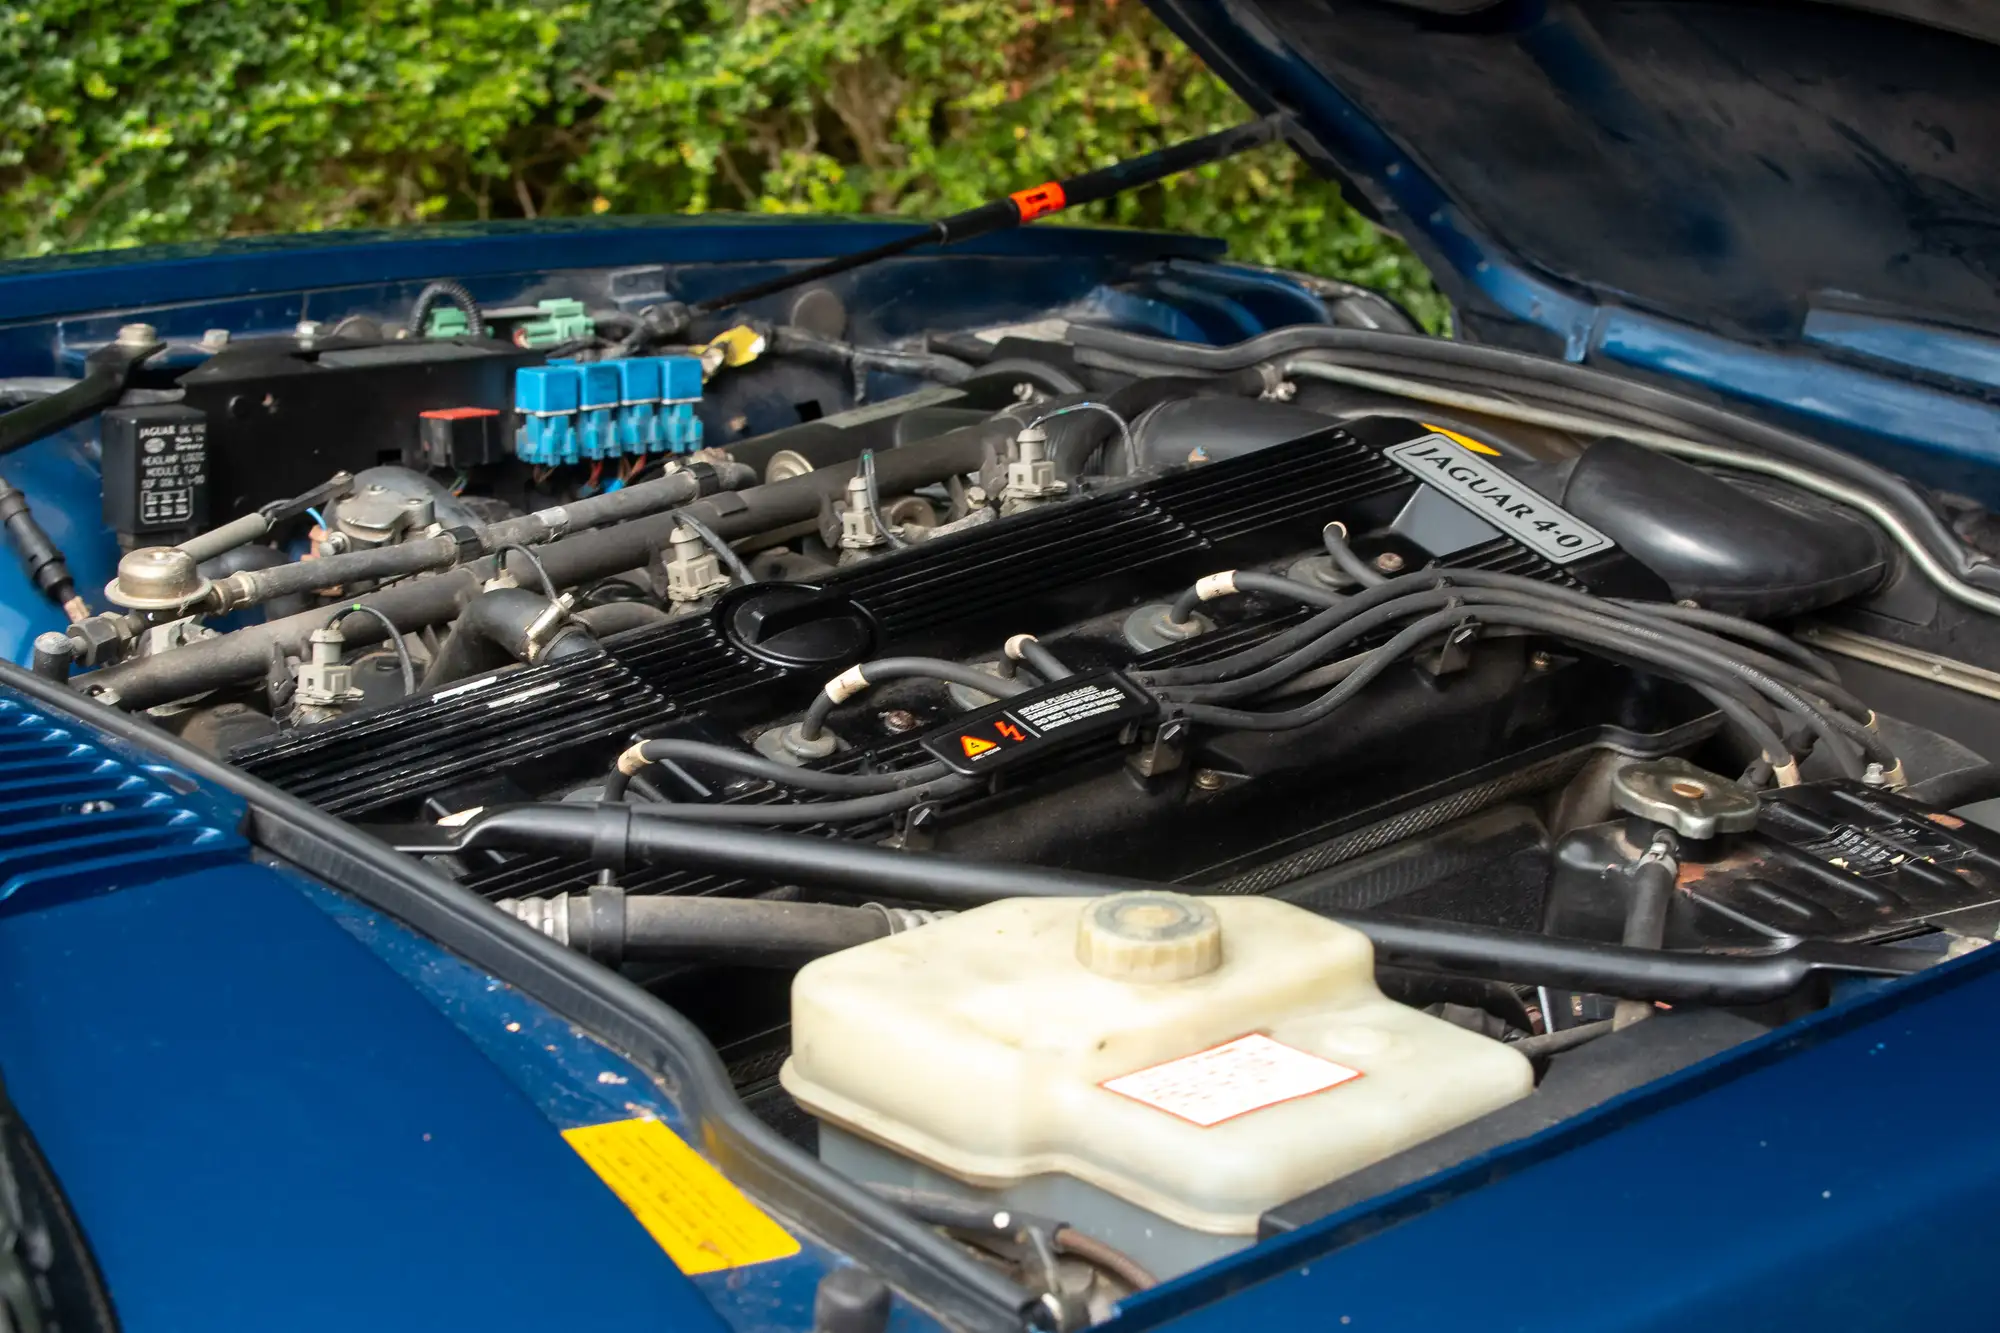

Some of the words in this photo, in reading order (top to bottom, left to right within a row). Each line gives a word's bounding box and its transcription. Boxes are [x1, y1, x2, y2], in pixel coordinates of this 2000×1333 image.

[139, 425, 176, 439] JAGUAR
[142, 454, 179, 466] HEADLAMP
[146, 464, 180, 477] MODULE
[1408, 447, 1533, 519] JAGUAR
